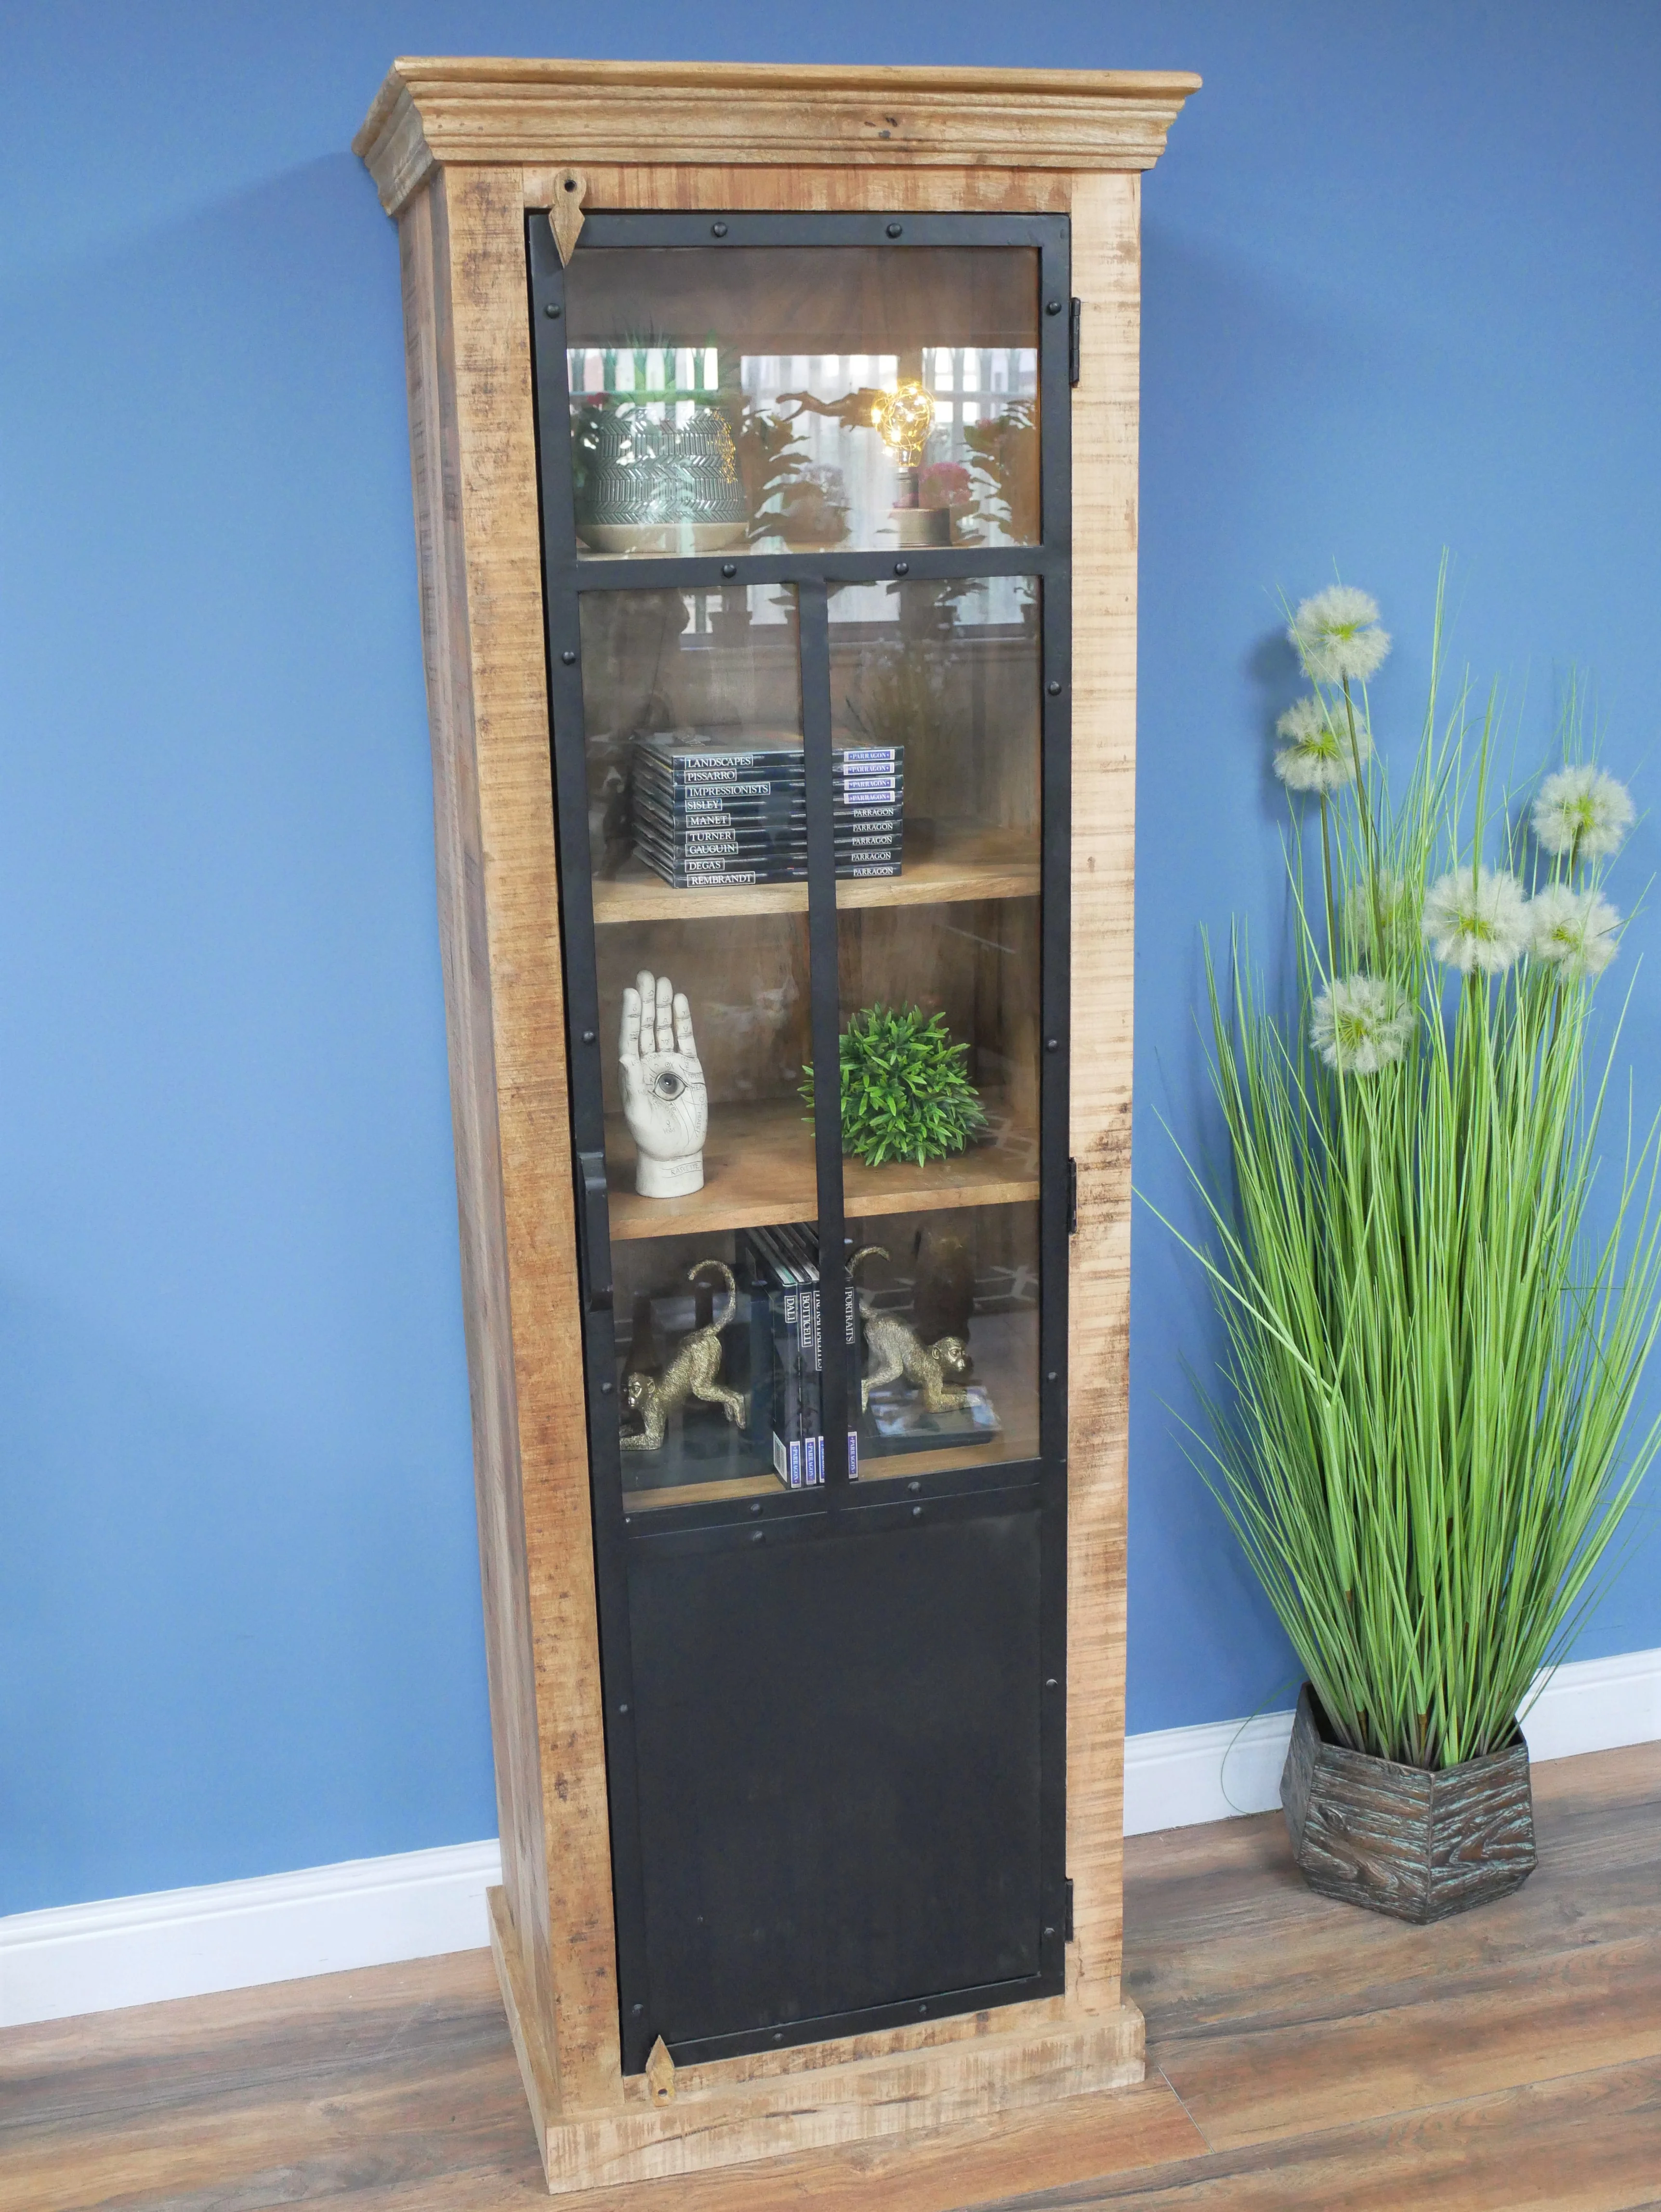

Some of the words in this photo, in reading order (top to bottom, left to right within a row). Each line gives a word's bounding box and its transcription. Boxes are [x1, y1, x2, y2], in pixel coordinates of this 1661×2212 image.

[852, 751, 886, 760] PARRAGON
[687, 757, 751, 768] LANDSCAPES
[851, 764, 886, 773] PARRAGON
[687, 771, 735, 781] PISSARRO
[852, 778, 887, 788] PARRAGON
[690, 785, 768, 797] IMPRESSIONISTS
[852, 792, 886, 801] PARRAGON
[687, 800, 719, 810] SISLEY
[854, 808, 894, 817] PARRAGON
[690, 816, 727, 825] MANET
[853, 823, 893, 832] PARRAGON
[690, 831, 732, 842] TURNER
[852, 836, 892, 845] PARRAGON
[689, 844, 736, 854] GAUGUIN
[851, 852, 891, 861] PARRAGON
[689, 861, 721, 870] DEGAS
[854, 867, 893, 876] PARRAGON
[691, 874, 752, 885] REMBRANDT
[786, 1298, 795, 1321] DALI
[802, 1295, 812, 1345] BOTTICELLI
[845, 1290, 854, 1342] PORTRAITS
